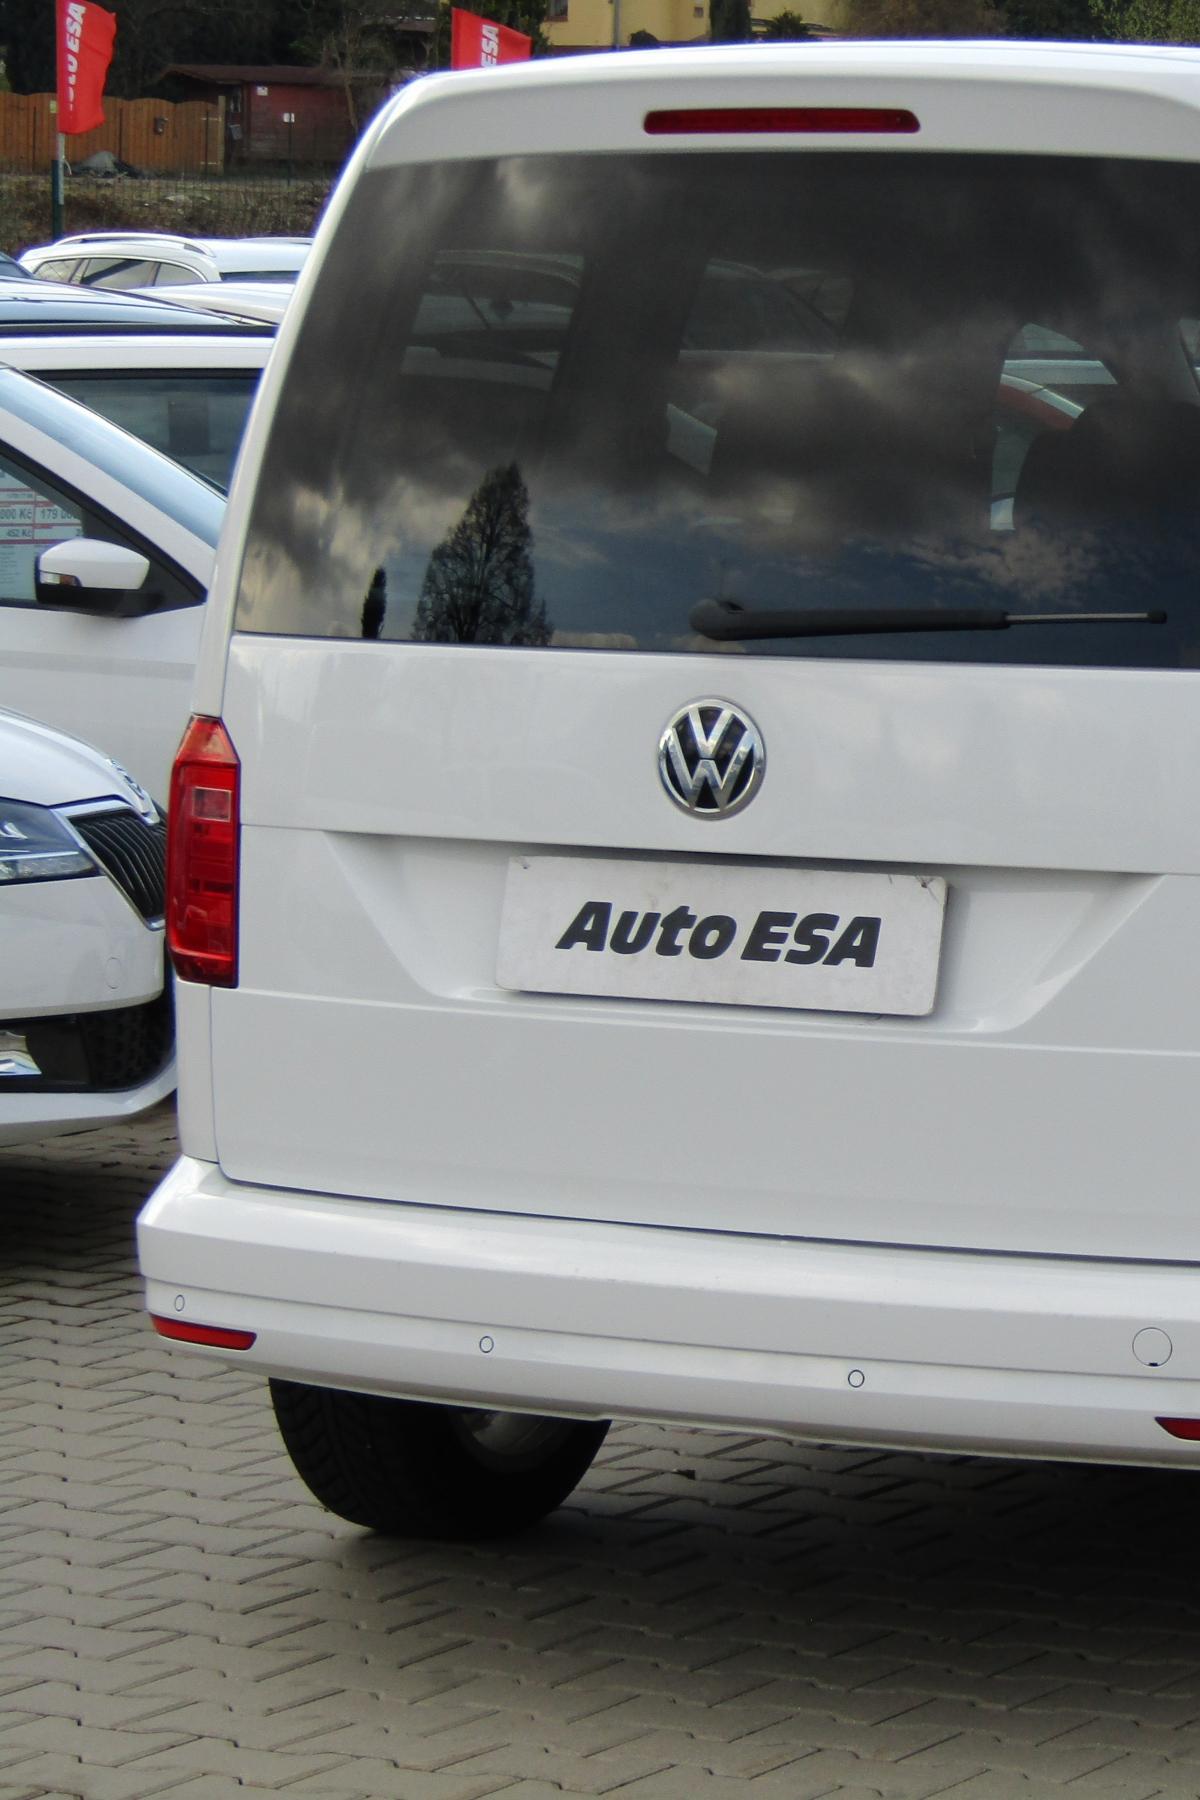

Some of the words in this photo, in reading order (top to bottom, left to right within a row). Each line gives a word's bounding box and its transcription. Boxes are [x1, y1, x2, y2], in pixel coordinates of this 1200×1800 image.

[66, 2, 86, 54] ESA
[481, 24, 499, 67] ESA
[554, 900, 737, 960] Auto
[740, 911, 882, 968] ESA
